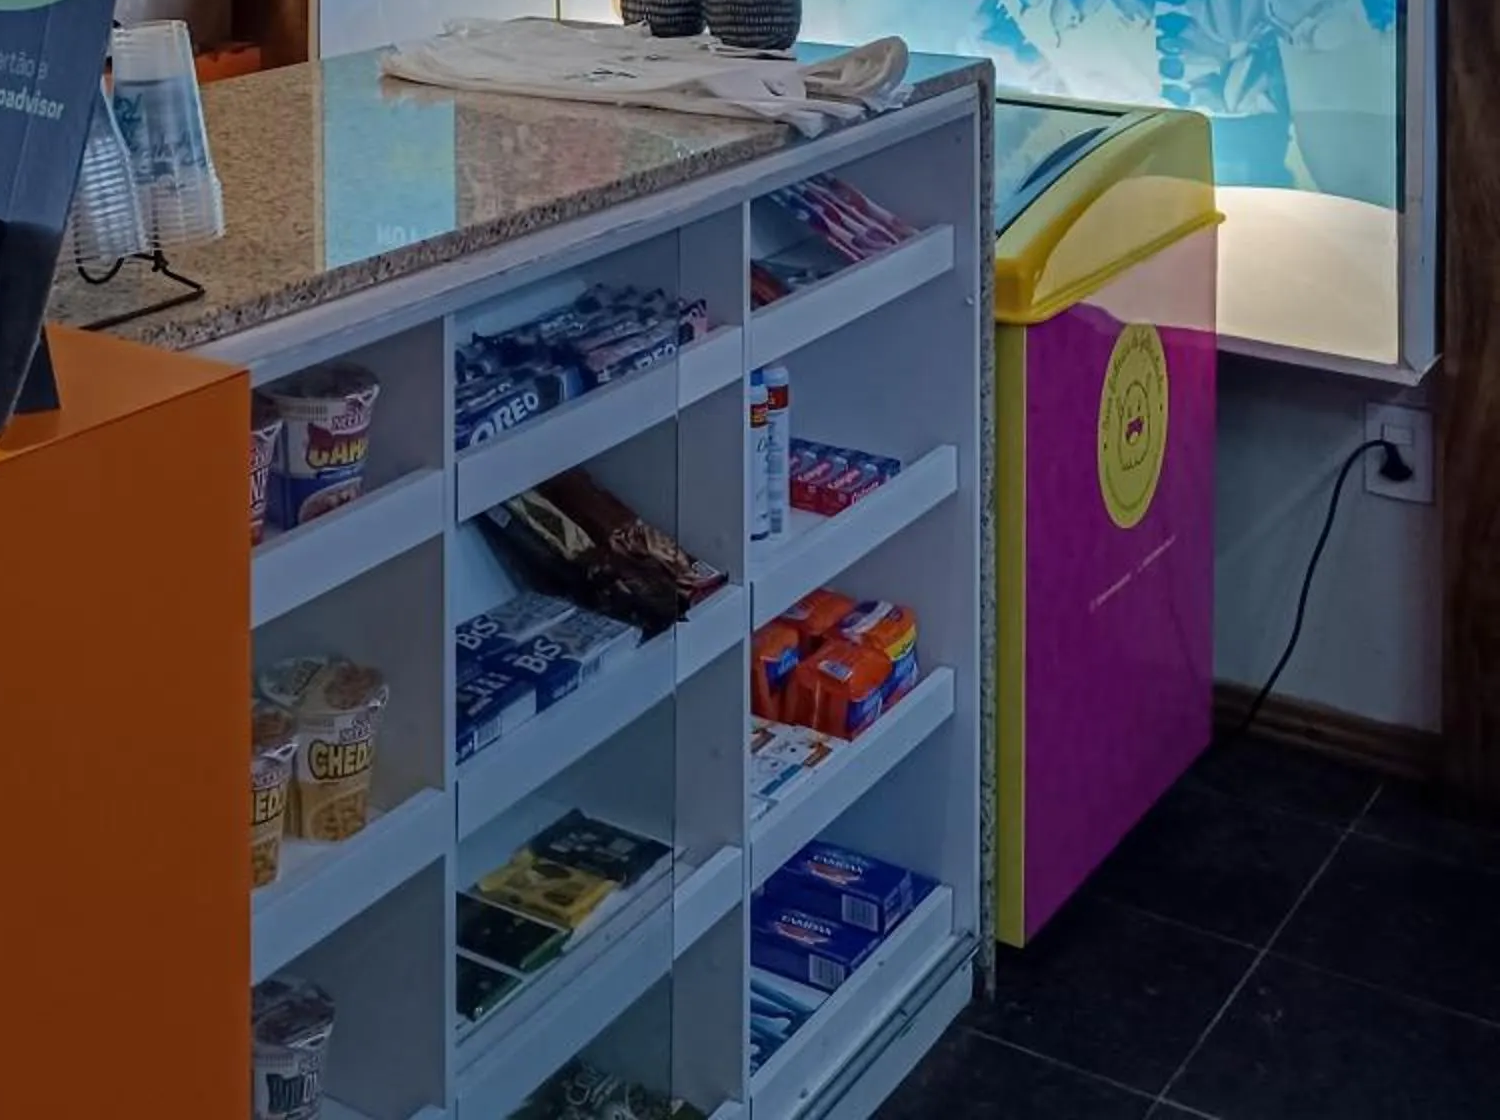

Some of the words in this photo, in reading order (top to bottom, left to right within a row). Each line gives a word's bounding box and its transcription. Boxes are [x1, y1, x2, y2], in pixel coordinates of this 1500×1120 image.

[469, 392, 540, 447] OREO
[456, 615, 501, 651] BIS
[513, 633, 563, 674] BIS
[309, 740, 373, 780] CHED
